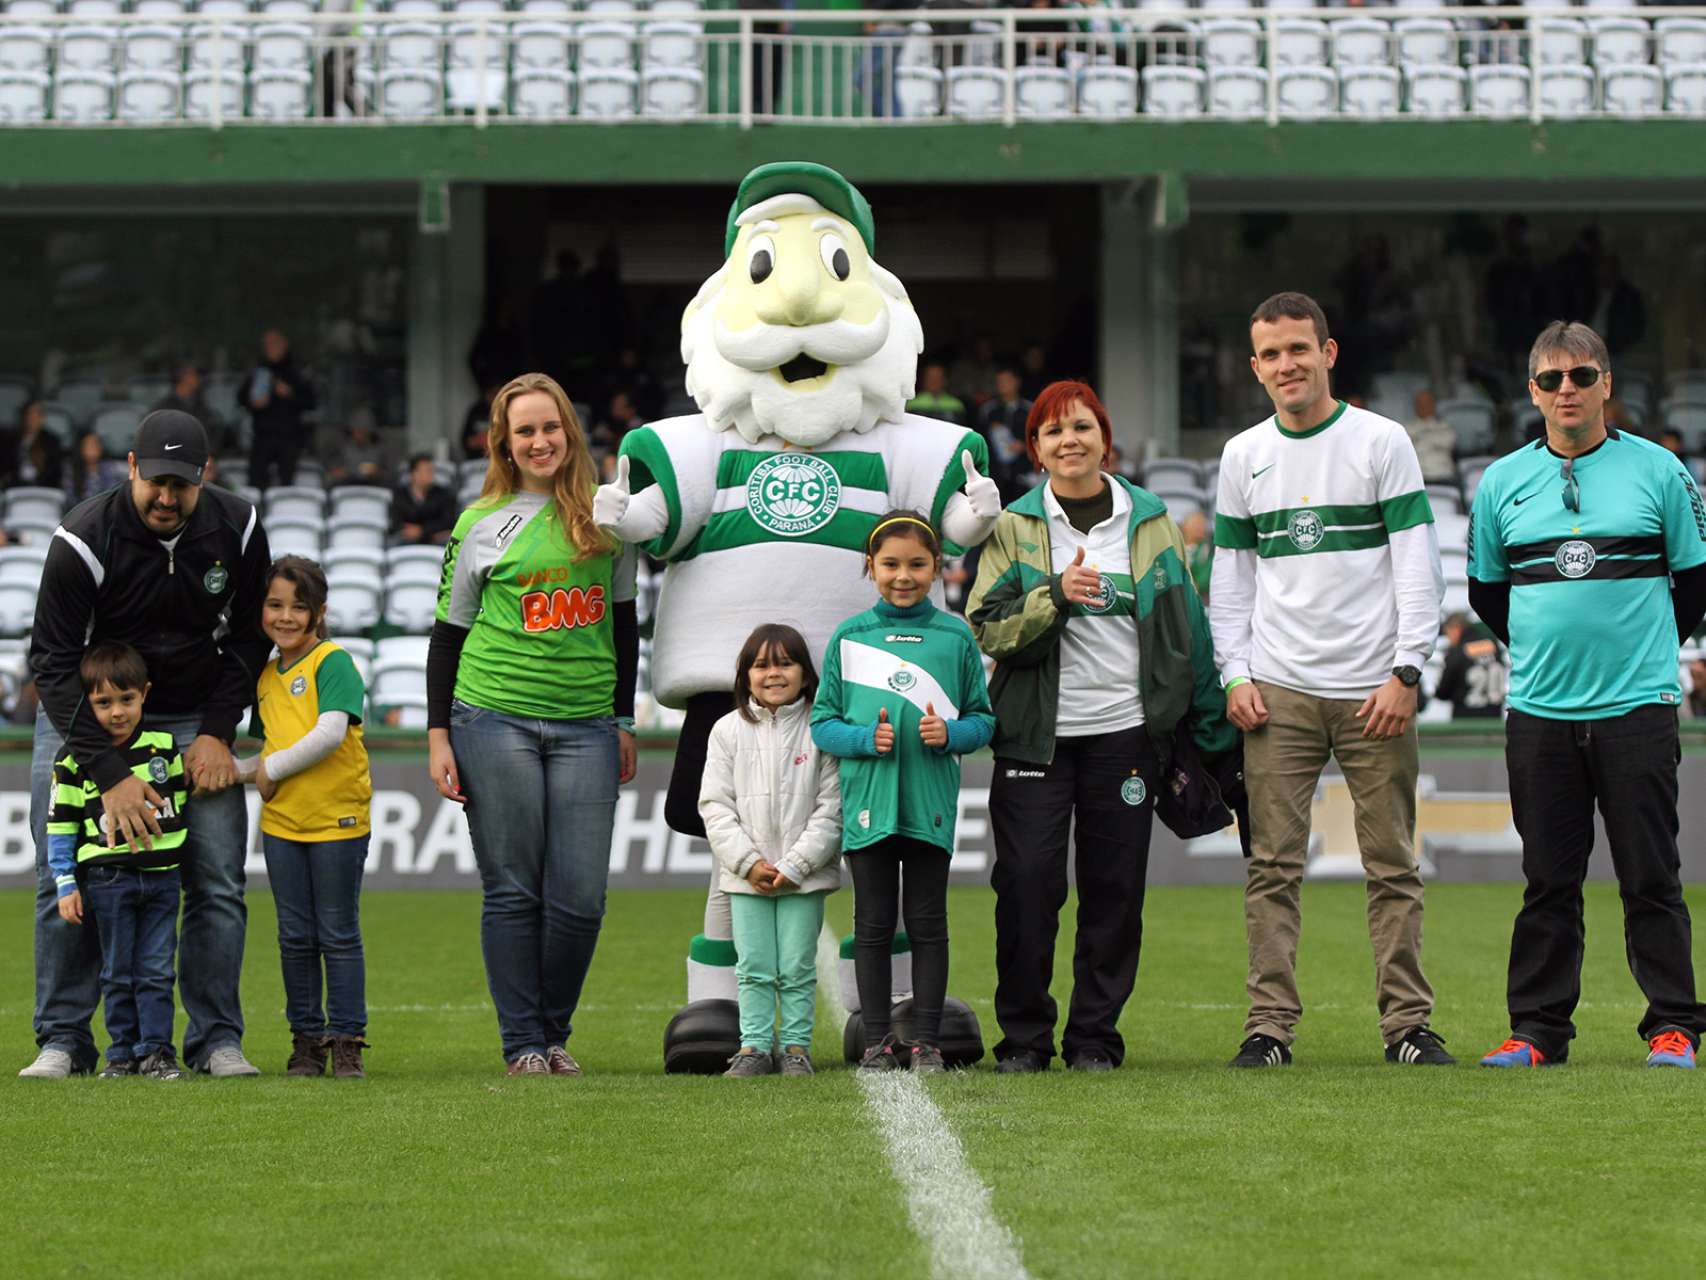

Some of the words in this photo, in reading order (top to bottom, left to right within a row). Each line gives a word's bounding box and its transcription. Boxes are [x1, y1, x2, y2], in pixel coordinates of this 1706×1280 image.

[750, 463, 774, 515] CORITIBA
[822, 485, 839, 515] CLUB
[765, 480, 821, 502] CFC
[517, 566, 569, 588] BANCO
[521, 584, 606, 632] BMG
